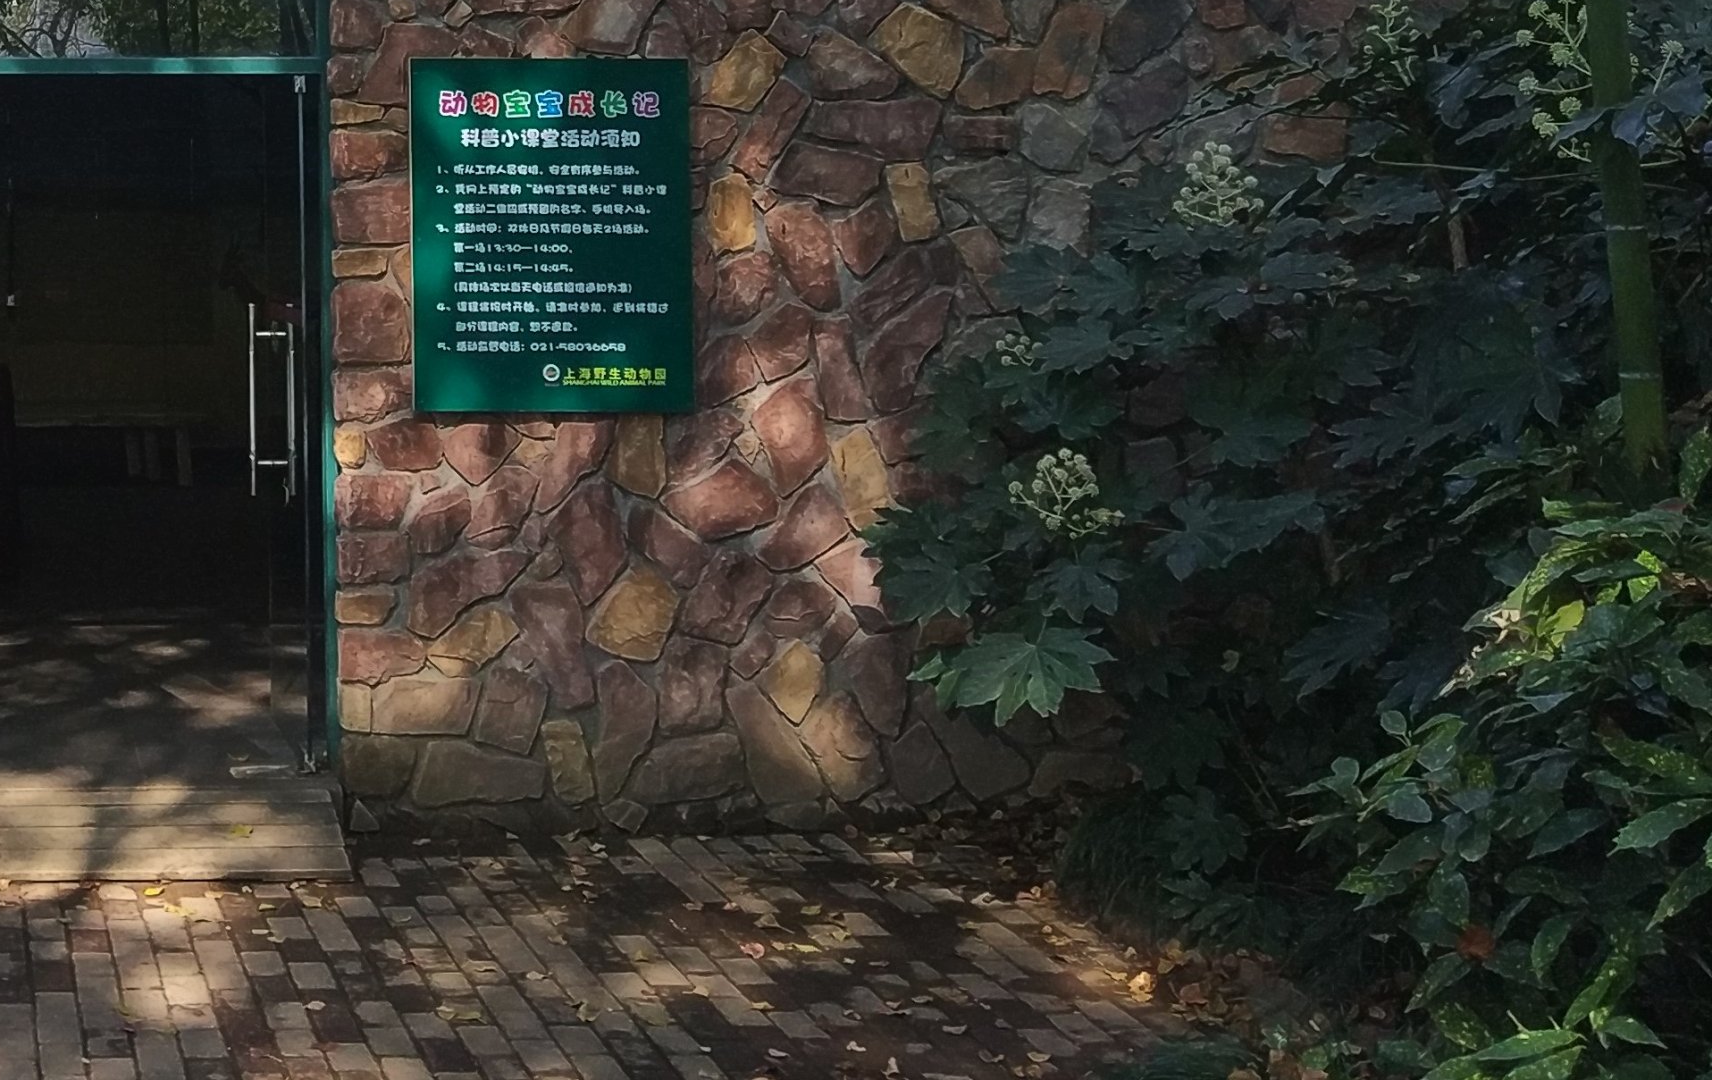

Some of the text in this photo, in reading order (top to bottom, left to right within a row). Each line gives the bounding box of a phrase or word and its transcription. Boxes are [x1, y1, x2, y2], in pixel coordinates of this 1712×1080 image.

[439, 89, 661, 119] 动物宝宝成长记
[460, 127, 641, 149] 科普小课堂活动须知
[563, 367, 667, 380] 上海野生动物园
